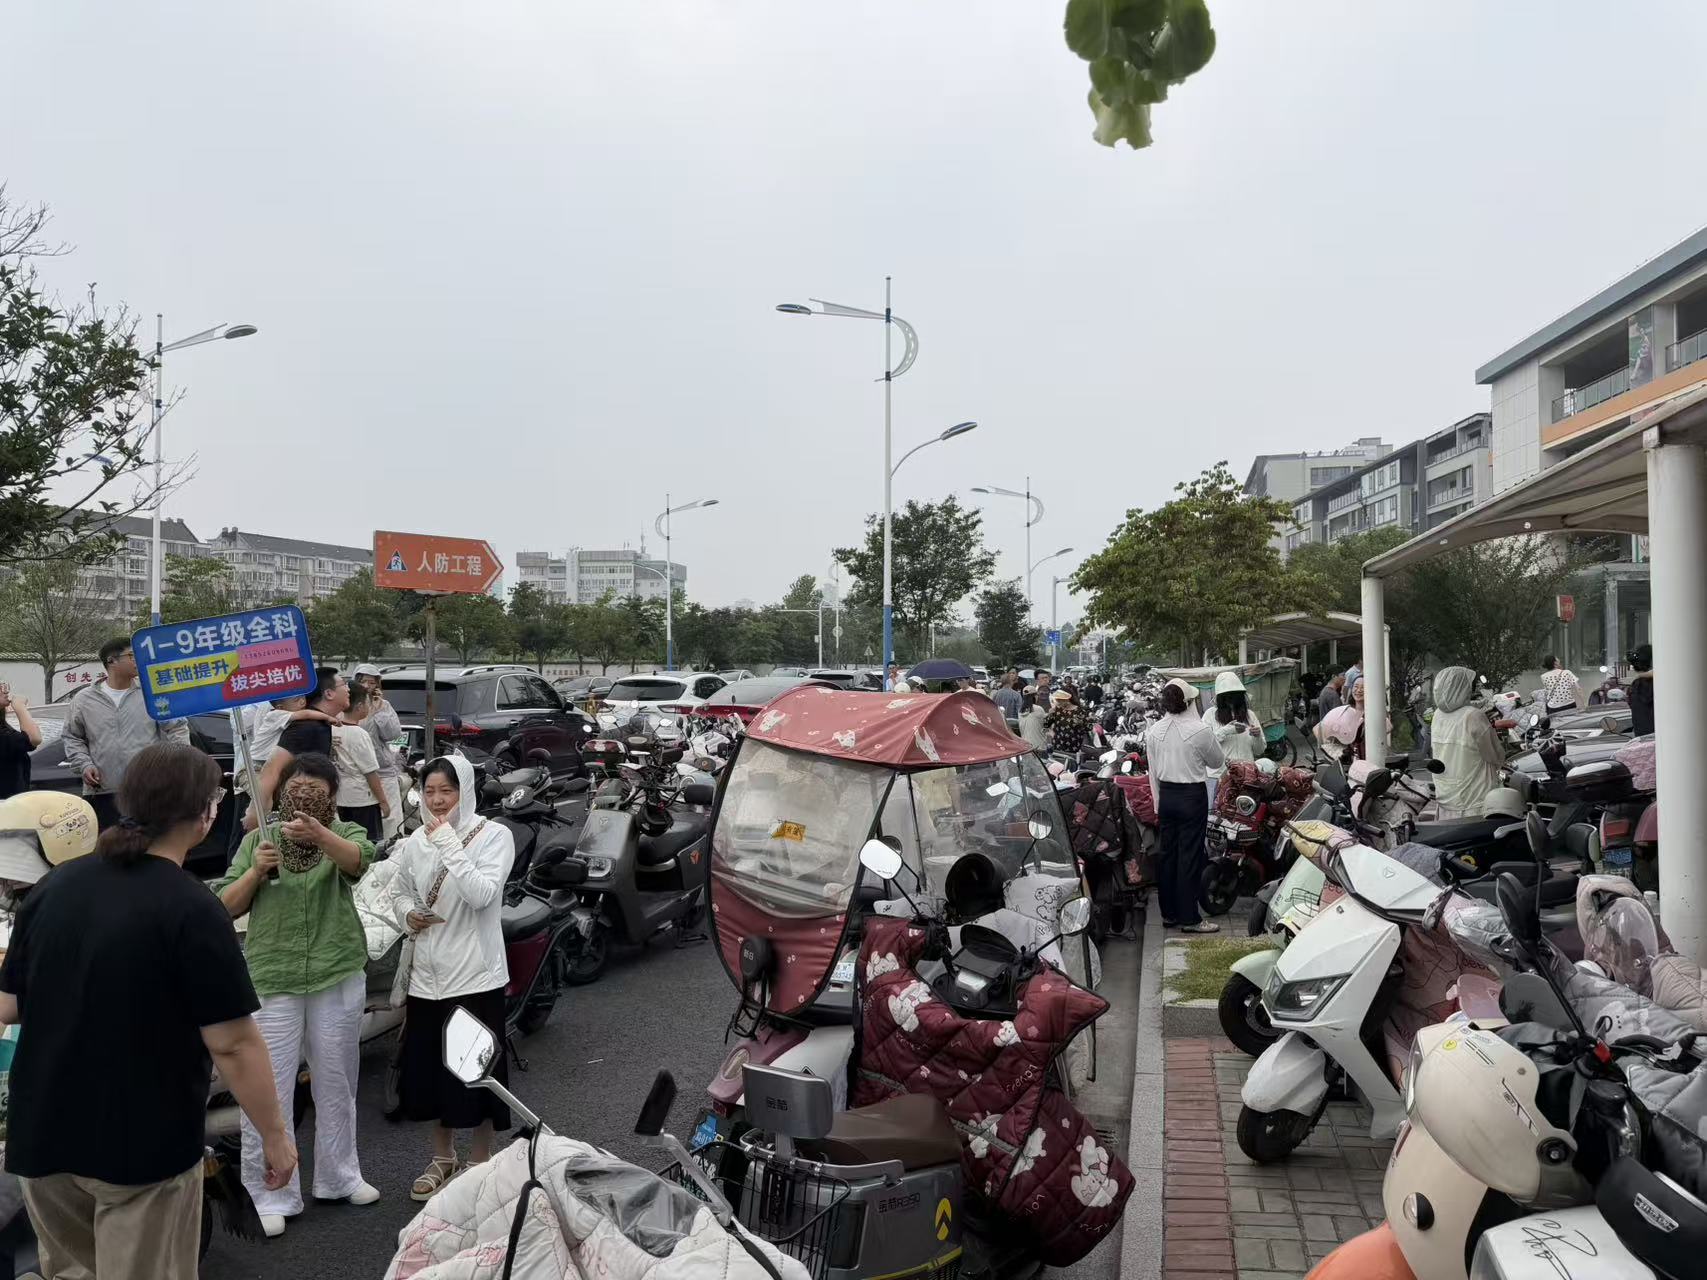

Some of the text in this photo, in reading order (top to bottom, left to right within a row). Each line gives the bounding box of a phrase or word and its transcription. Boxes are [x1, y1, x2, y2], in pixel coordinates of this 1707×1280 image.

[416, 550, 482, 576] 人防工程
[140, 610, 298, 660] 1-9年级全科
[155, 658, 229, 687] 基础提升
[230, 664, 303, 692] 拔尖培优
